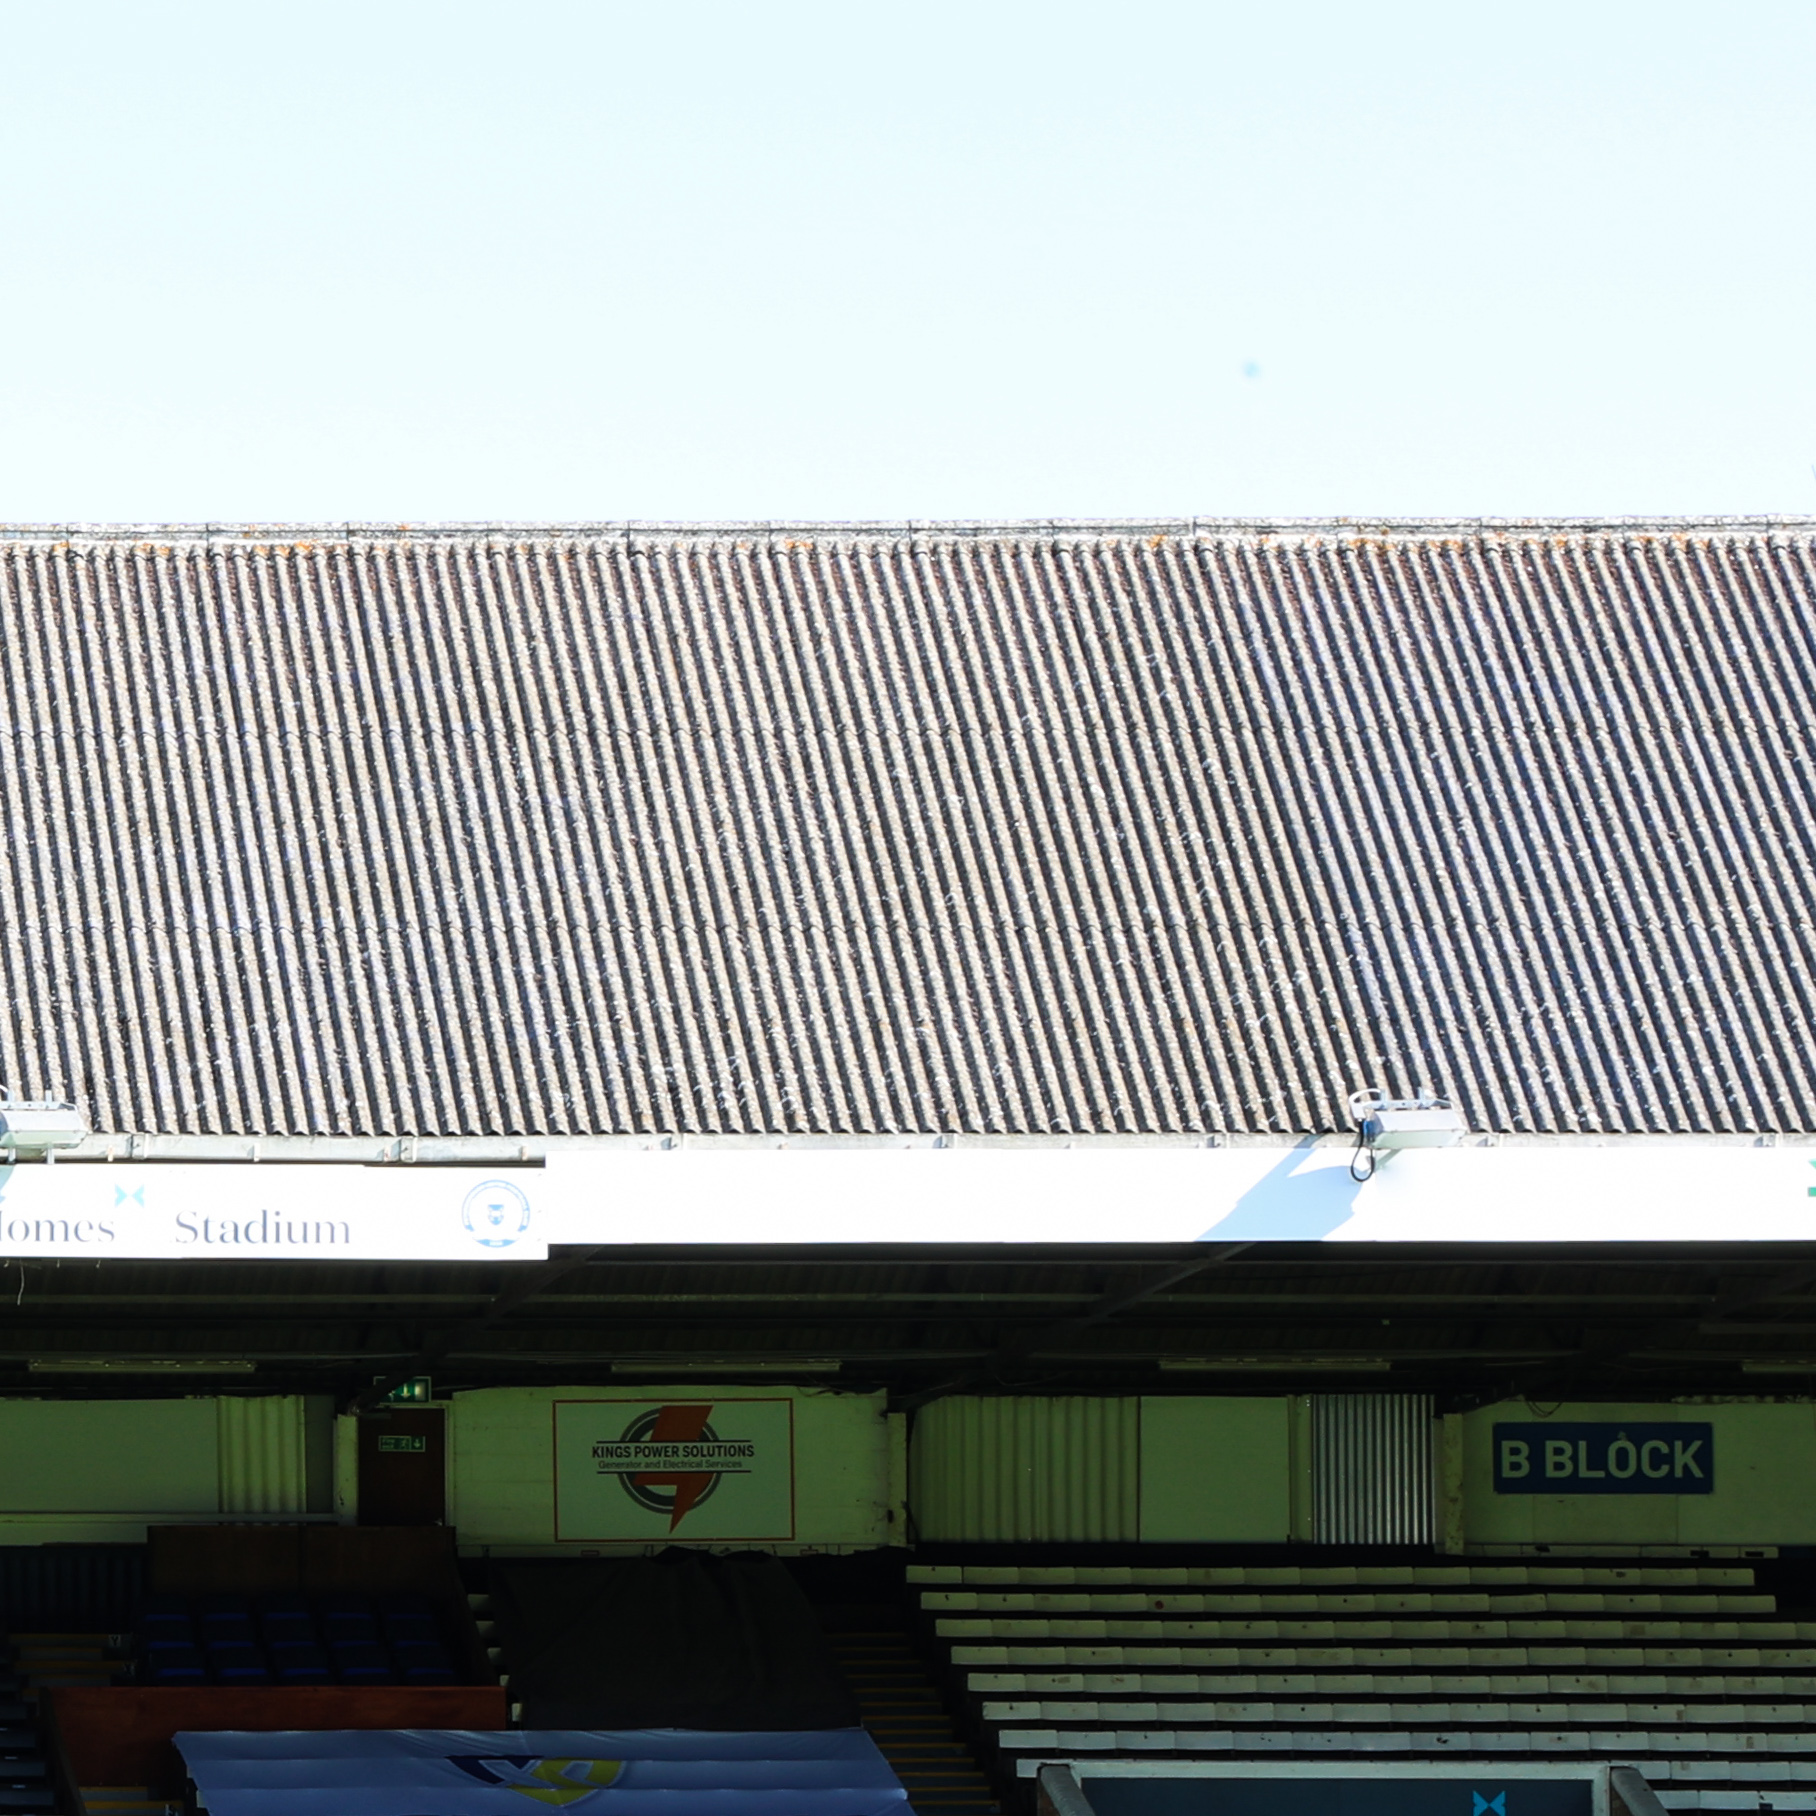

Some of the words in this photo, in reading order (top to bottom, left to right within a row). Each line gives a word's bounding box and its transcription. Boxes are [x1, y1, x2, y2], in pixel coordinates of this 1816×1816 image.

[174, 1209, 352, 1245] Stadium
[592, 1446, 631, 1458] KINGS
[634, 1446, 679, 1458] POWER
[682, 1445, 755, 1458] SOLUTIONS
[1501, 1439, 1530, 1479] B
[1544, 1439, 1705, 1479] BLOCK
[598, 1459, 642, 1469] Generator
[644, 1460, 660, 1469] and
[663, 1459, 704, 1469] Electrical
[706, 1459, 743, 1469] Services
